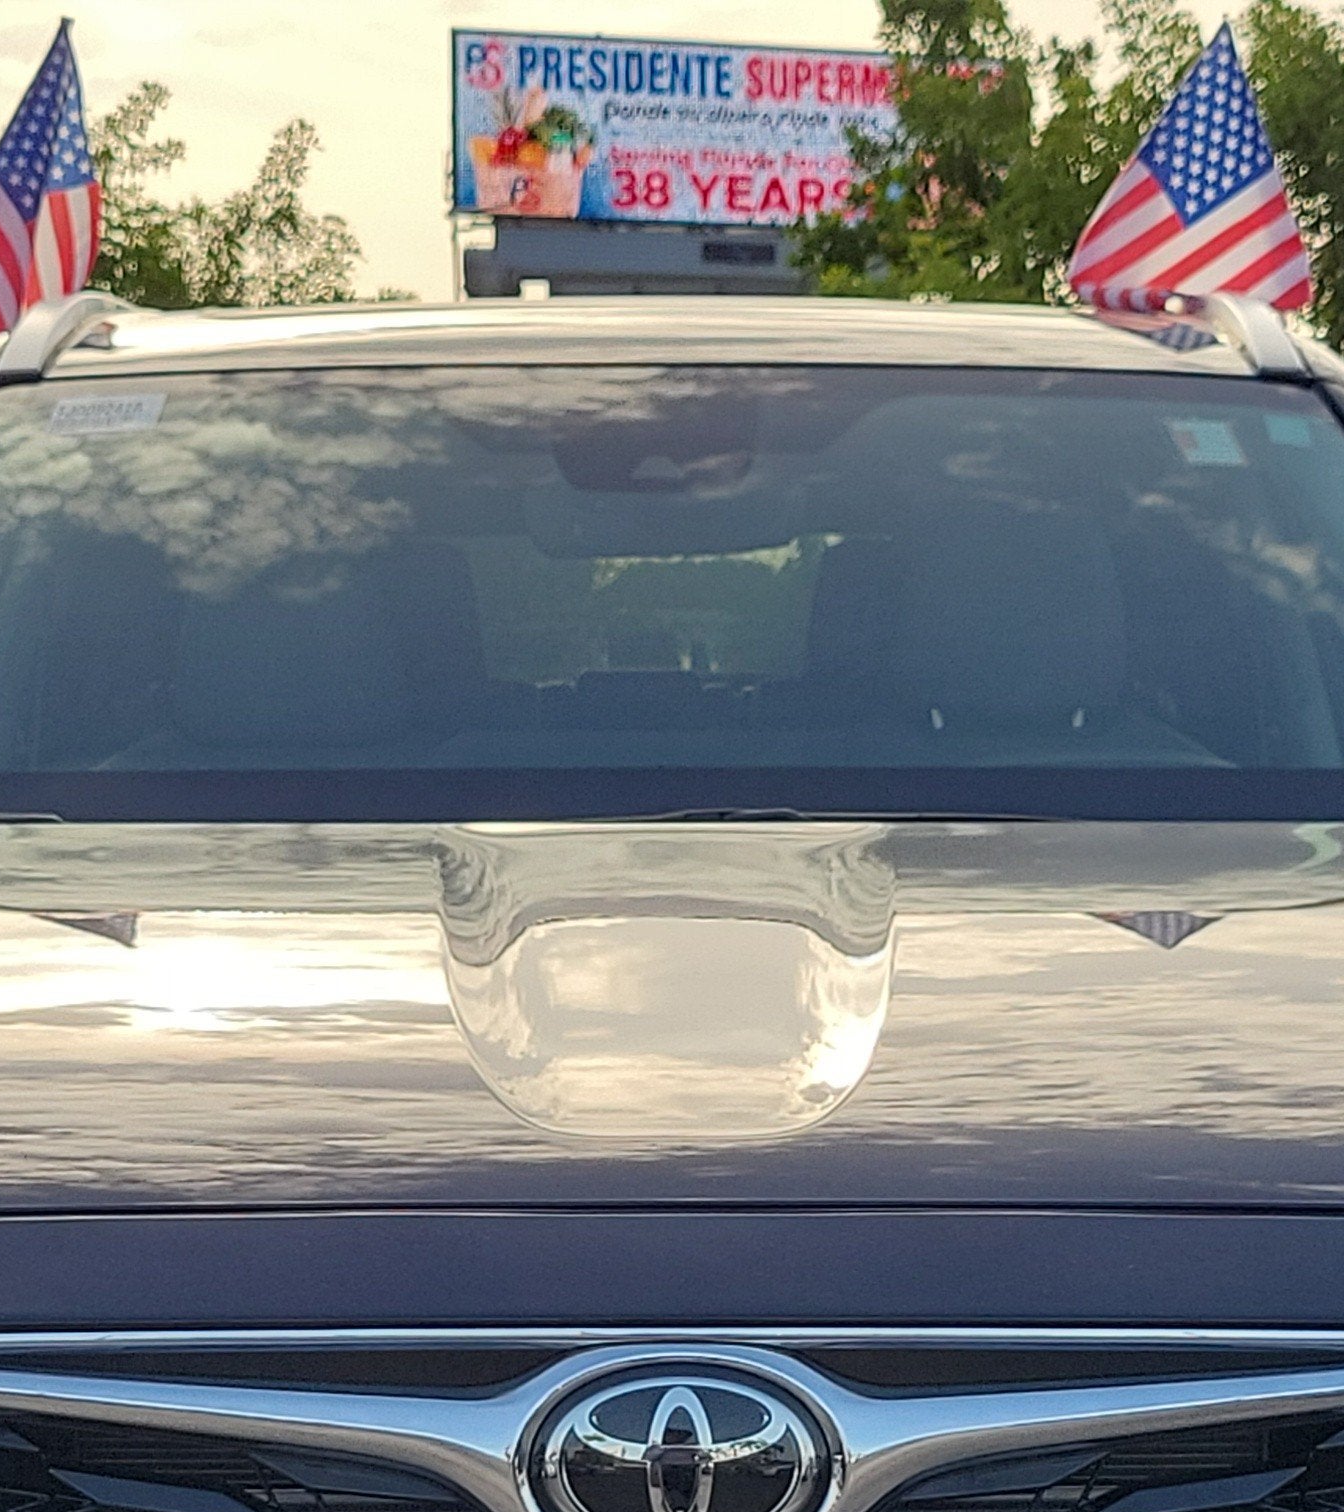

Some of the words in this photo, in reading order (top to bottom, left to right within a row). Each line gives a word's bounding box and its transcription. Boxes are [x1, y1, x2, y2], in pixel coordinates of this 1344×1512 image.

[518, 45, 731, 97] PRESIDENTE
[746, 57, 892, 104] SUPERM
[612, 169, 671, 209] 38
